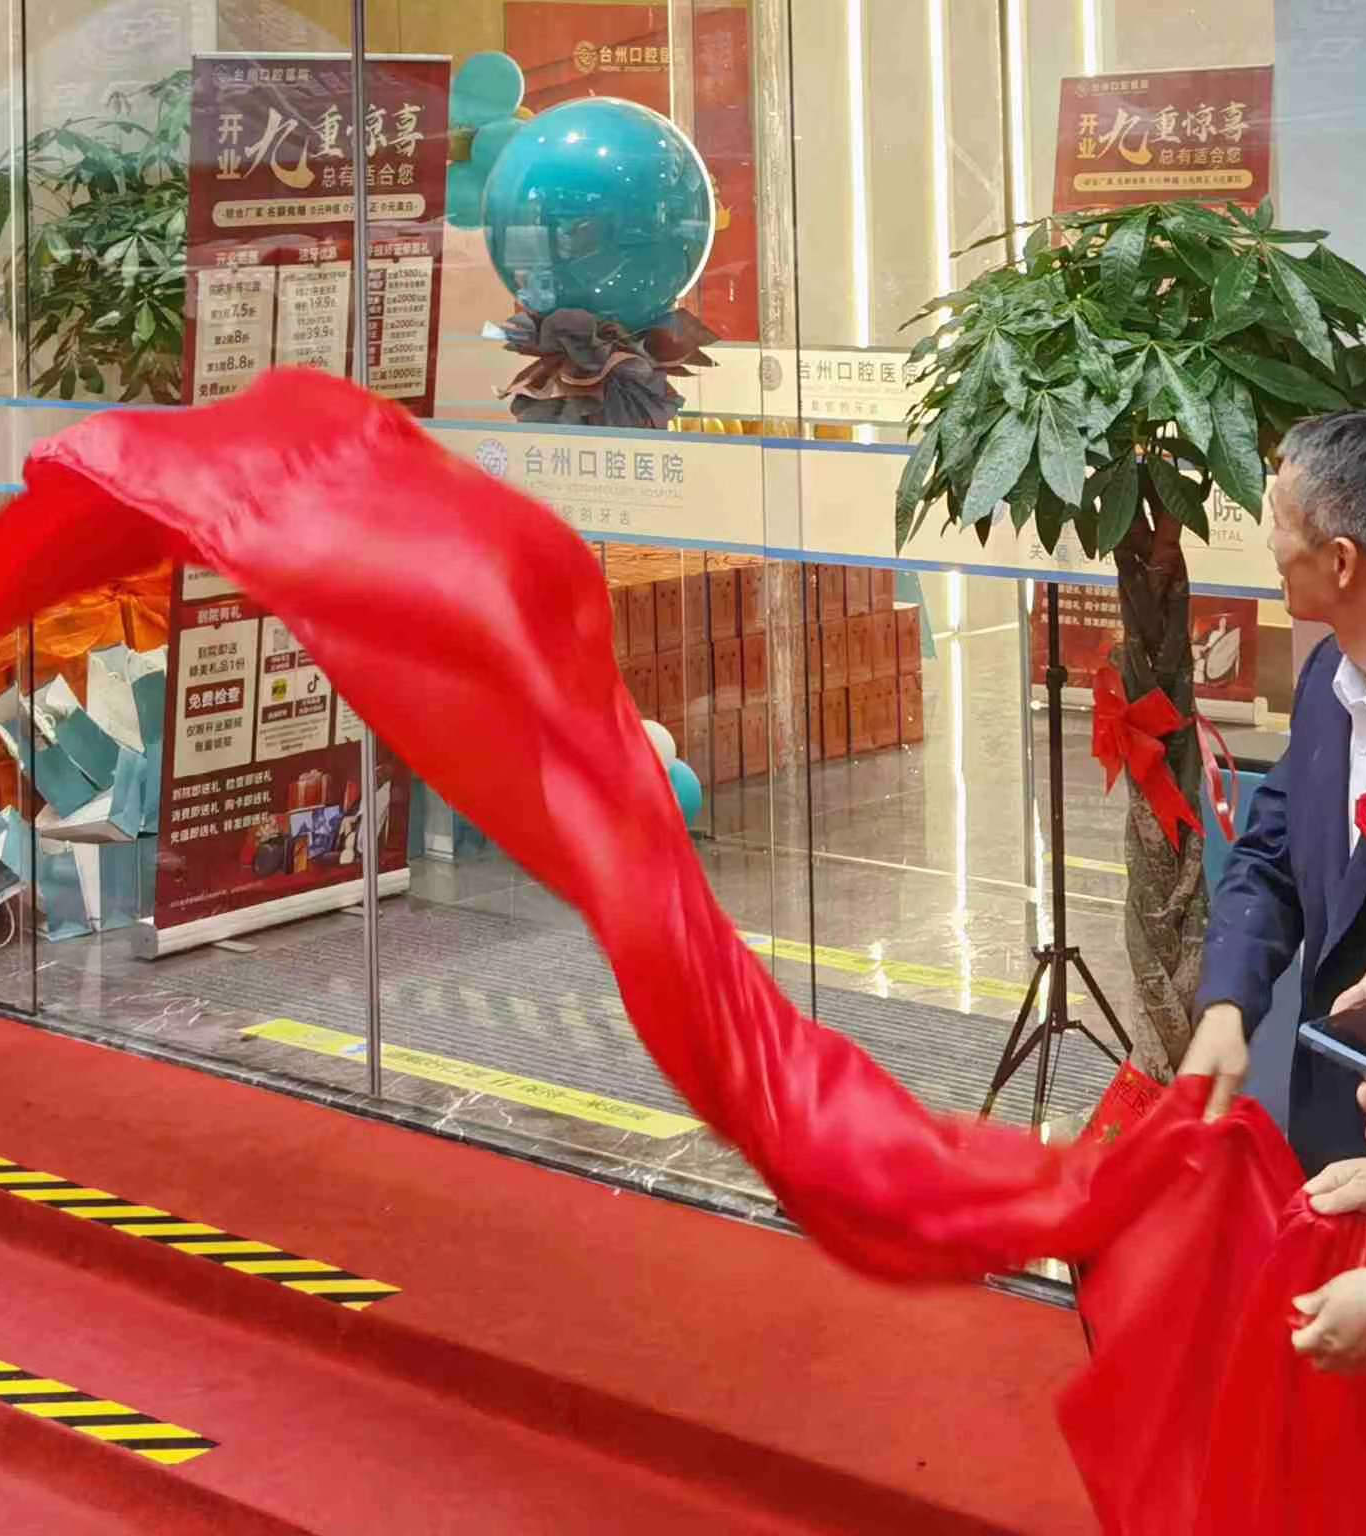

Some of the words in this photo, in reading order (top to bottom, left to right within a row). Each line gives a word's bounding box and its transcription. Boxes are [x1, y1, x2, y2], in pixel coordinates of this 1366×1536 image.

[215, 113, 244, 180] 开业
[1076, 113, 1098, 159] 开业
[523, 444, 684, 484] 台州口腔医院
